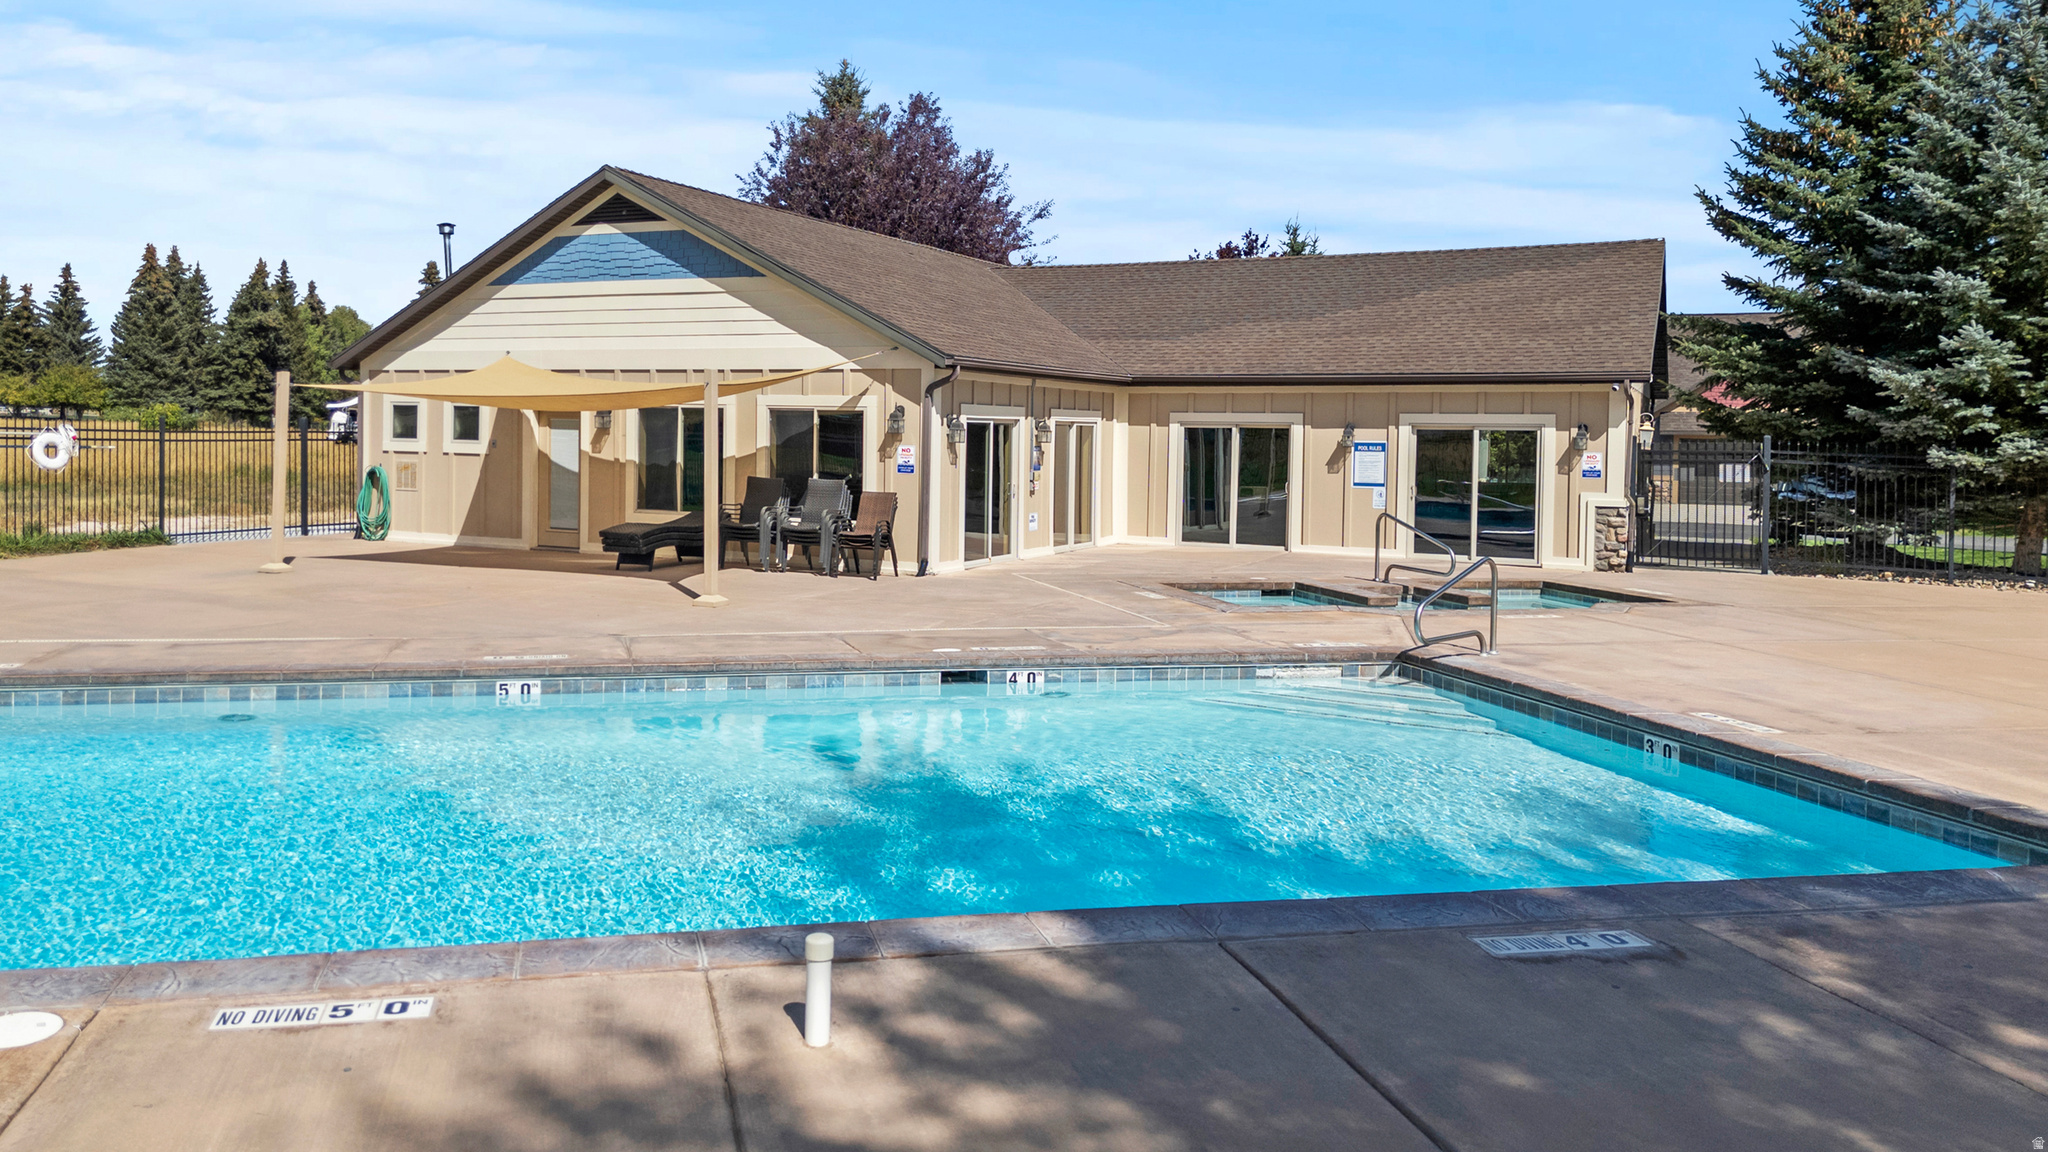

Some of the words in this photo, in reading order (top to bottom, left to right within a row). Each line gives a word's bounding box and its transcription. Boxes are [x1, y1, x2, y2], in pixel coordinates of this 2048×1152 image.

[1009, 672, 1018, 683] 4
[1027, 672, 1036, 683] 0
[499, 683, 509, 696] 5
[521, 683, 531, 695] 0
[1646, 739, 1654, 753] 3
[1663, 743, 1671, 759] 0
[1479, 939, 1511, 951] NO
[1504, 936, 1565, 950] DIVING
[1565, 935, 1590, 948] 4
[1597, 933, 1629, 945] 0
[215, 1010, 246, 1026] NO
[251, 1006, 320, 1024] DIVING
[328, 1003, 355, 1019] 5
[383, 1001, 410, 1015] 0
